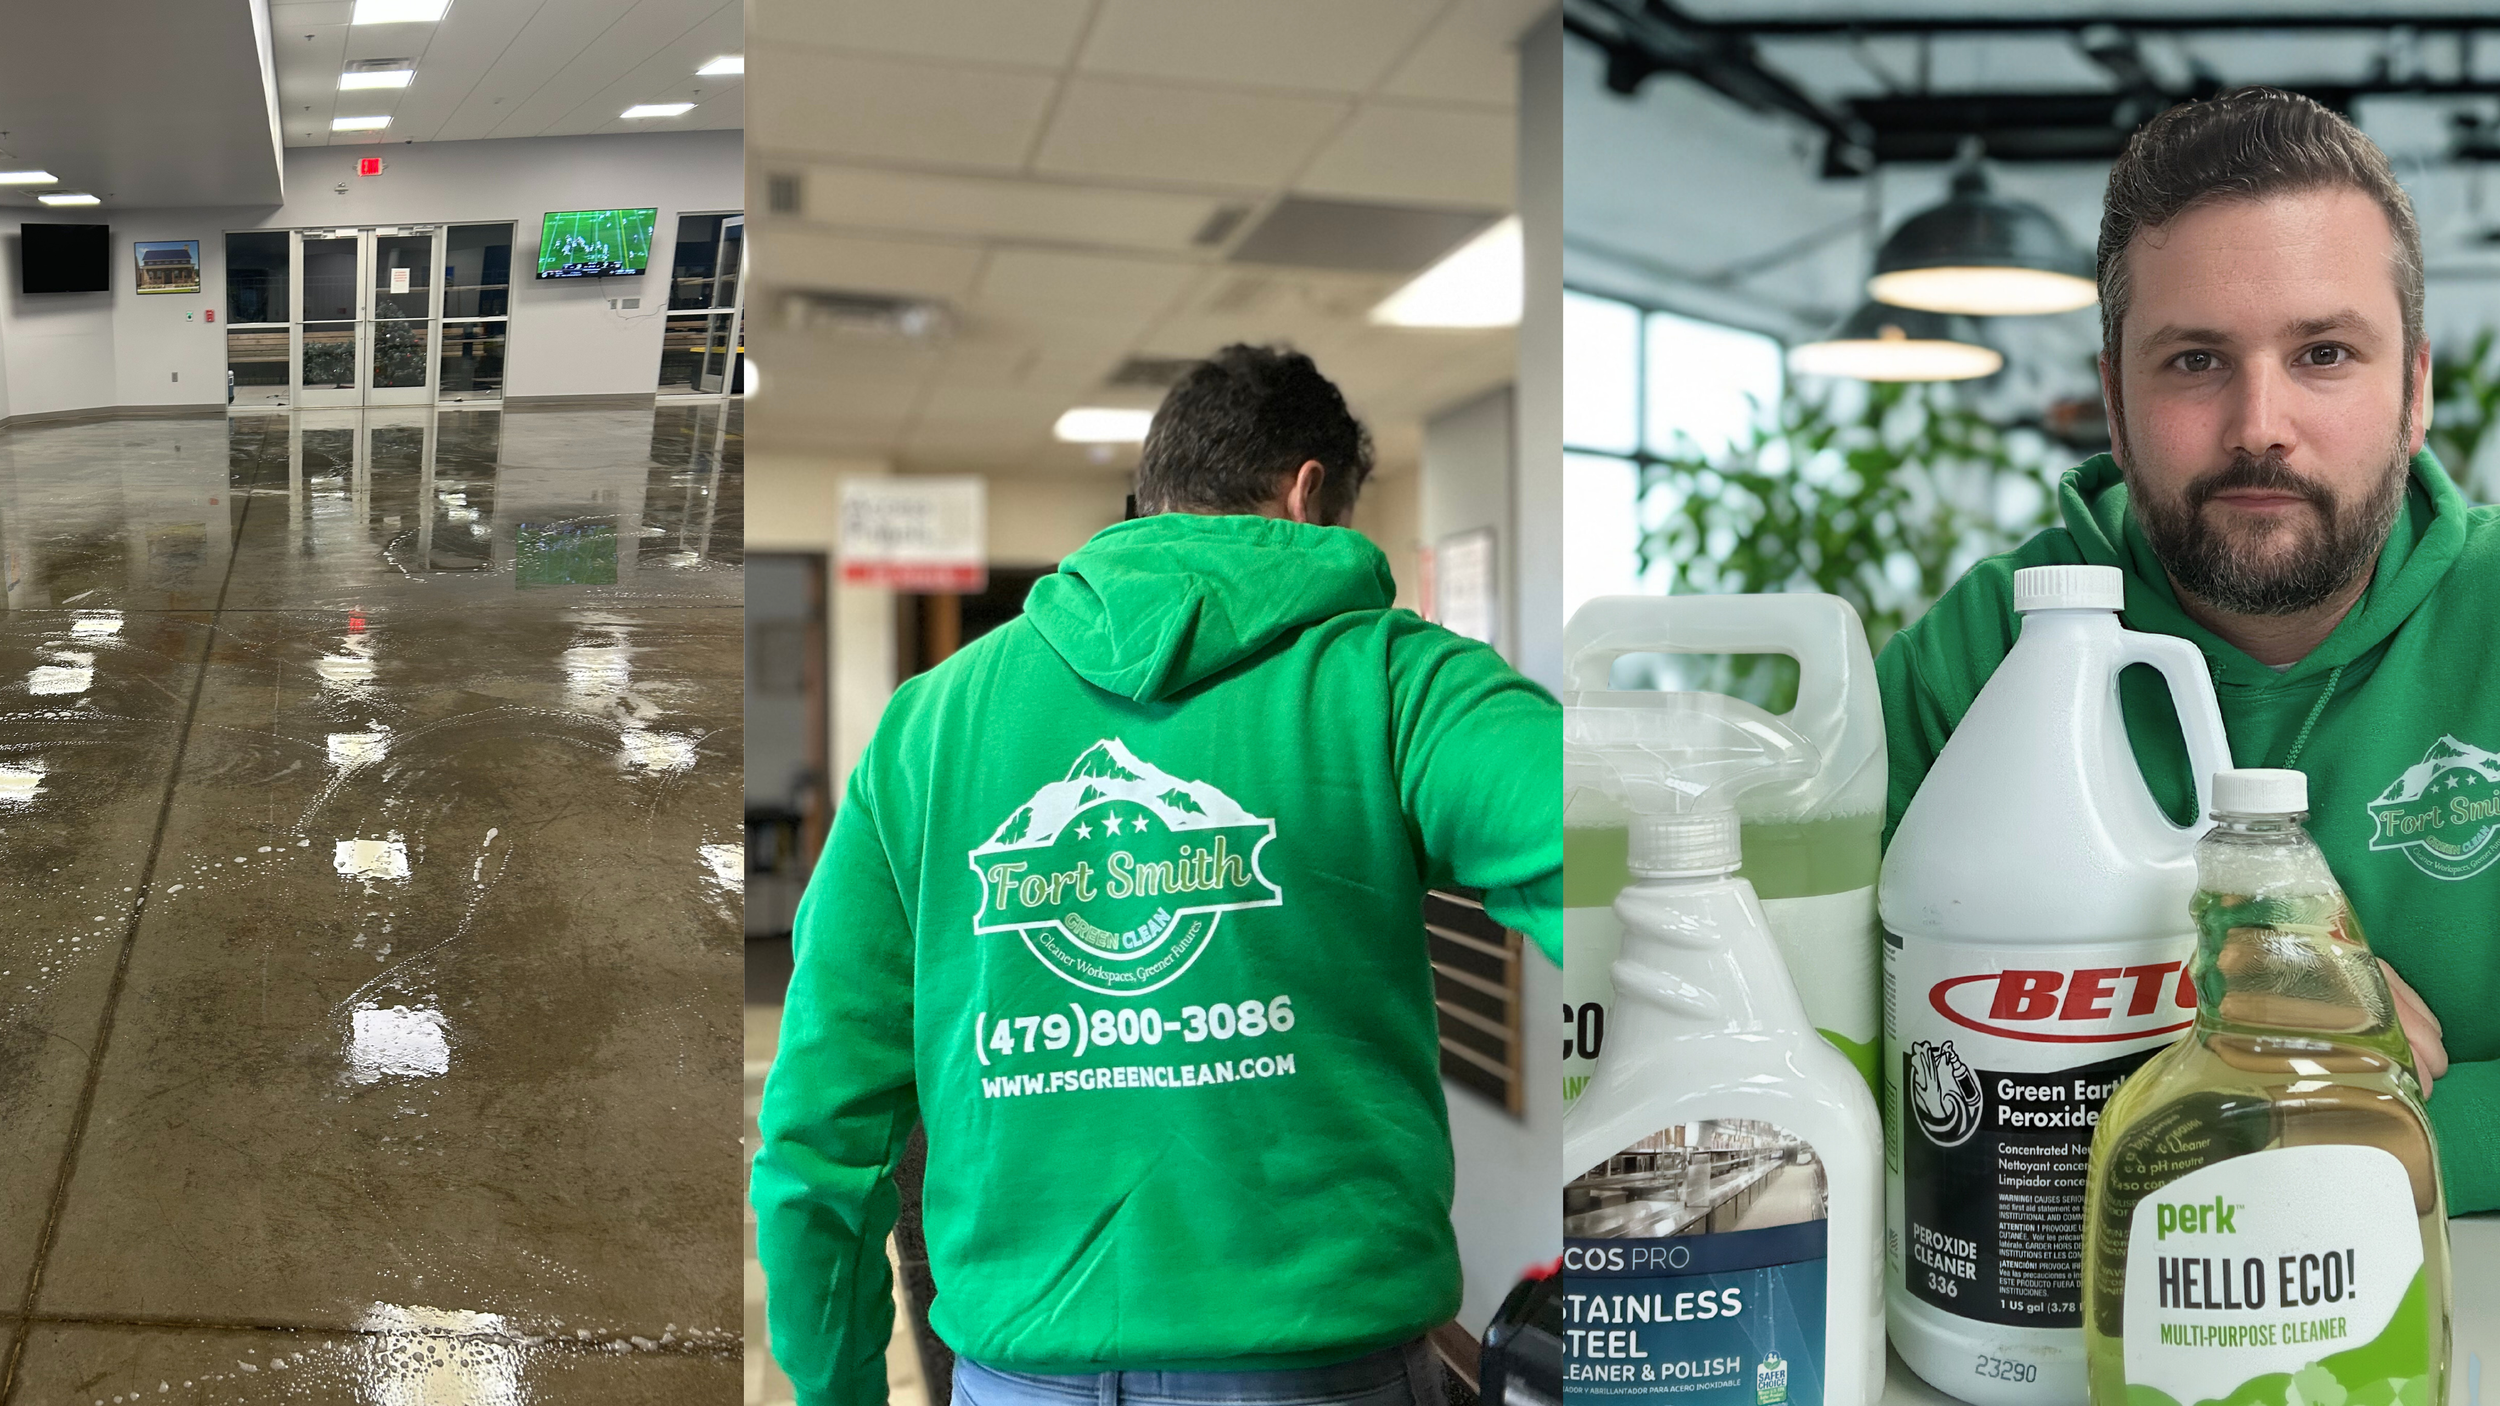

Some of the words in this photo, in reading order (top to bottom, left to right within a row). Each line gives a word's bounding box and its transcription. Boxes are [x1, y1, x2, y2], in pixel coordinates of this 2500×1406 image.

[2379, 806, 2445, 837] Fort
[987, 861, 1097, 909] Fort
[1106, 836, 1251, 898] Smith
[1064, 912, 1119, 950] GREEN
[1122, 906, 1171, 949] CLEAN
[1039, 932, 1075, 967] Cleaner
[1077, 958, 1137, 985] Workspaces,
[1136, 954, 1175, 982] Greener
[1171, 920, 1202, 958] Futures
[974, 994, 1296, 1066] (479)800-3086
[981, 1053, 1297, 1099] WWW.FSGREENCLEAN.COM
[1997, 1078, 2066, 1101] Green
[1998, 1104, 2099, 1127] Peroxide
[1998, 1142, 2068, 1156] Concentrated
[1998, 1158, 2050, 1174] Nettoyant
[1998, 1174, 2051, 1189] Limpiador
[2054, 1178, 2086, 1187] conce
[1998, 1193, 2033, 1202] WARNING!
[2034, 1195, 2060, 1203] CAUSES
[1999, 1211, 2045, 1221] INSTITUTIONAL
[2047, 1213, 2061, 1221] AND
[1999, 1222, 2035, 1232] ATTENTION
[2042, 1224, 2077, 1232] PROVOQUE
[1913, 1222, 1977, 1260] PEROXIDE
[2025, 1242, 2052, 1250] GARDER
[2053, 1242, 2072, 1250] HORS
[1563, 1247, 1625, 1271] COS
[1632, 1246, 1690, 1271] PRO
[1914, 1244, 1977, 1280] CLEANER
[1999, 1248, 2042, 1259] INSTITUTIONS
[2044, 1251, 2052, 1259] ET
[2054, 1251, 2067, 1259] LES
[2039, 1262, 2070, 1270] PROVOCA
[1928, 1272, 1958, 1298] 336
[1999, 1278, 2015, 1286] ESTE
[2016, 1279, 2051, 1288] PRODUCTO
[2159, 1256, 2266, 1310] HELLO
[2278, 1248, 2356, 1308] ECO!
[1999, 1287, 2049, 1297] INSTITUCIONES.
[1563, 1287, 1743, 1324] TAINLESS
[2000, 1300, 2005, 1308] 1
[2009, 1301, 2024, 1310] US
[2027, 1302, 2044, 1314] gal
[2047, 1302, 2076, 1314] (3.78
[1563, 1329, 1649, 1358] TEEL
[2160, 1323, 2277, 1347] MULTI-PURPOSE
[2282, 1317, 2347, 1345] CLEANER
[1641, 1364, 1656, 1382] &
[1661, 1356, 1741, 1380] POLISH
[1758, 1370, 1785, 1382] SAFER
[1975, 1354, 2037, 1383] 23290
[1590, 1387, 1648, 1395] ABRILLANTADOR
[1649, 1386, 1669, 1394] PARA
[1669, 1384, 1695, 1393] ACERO
[1696, 1378, 1741, 1391] INOXIDABLE
[1758, 1378, 1785, 1389] CHOICE
